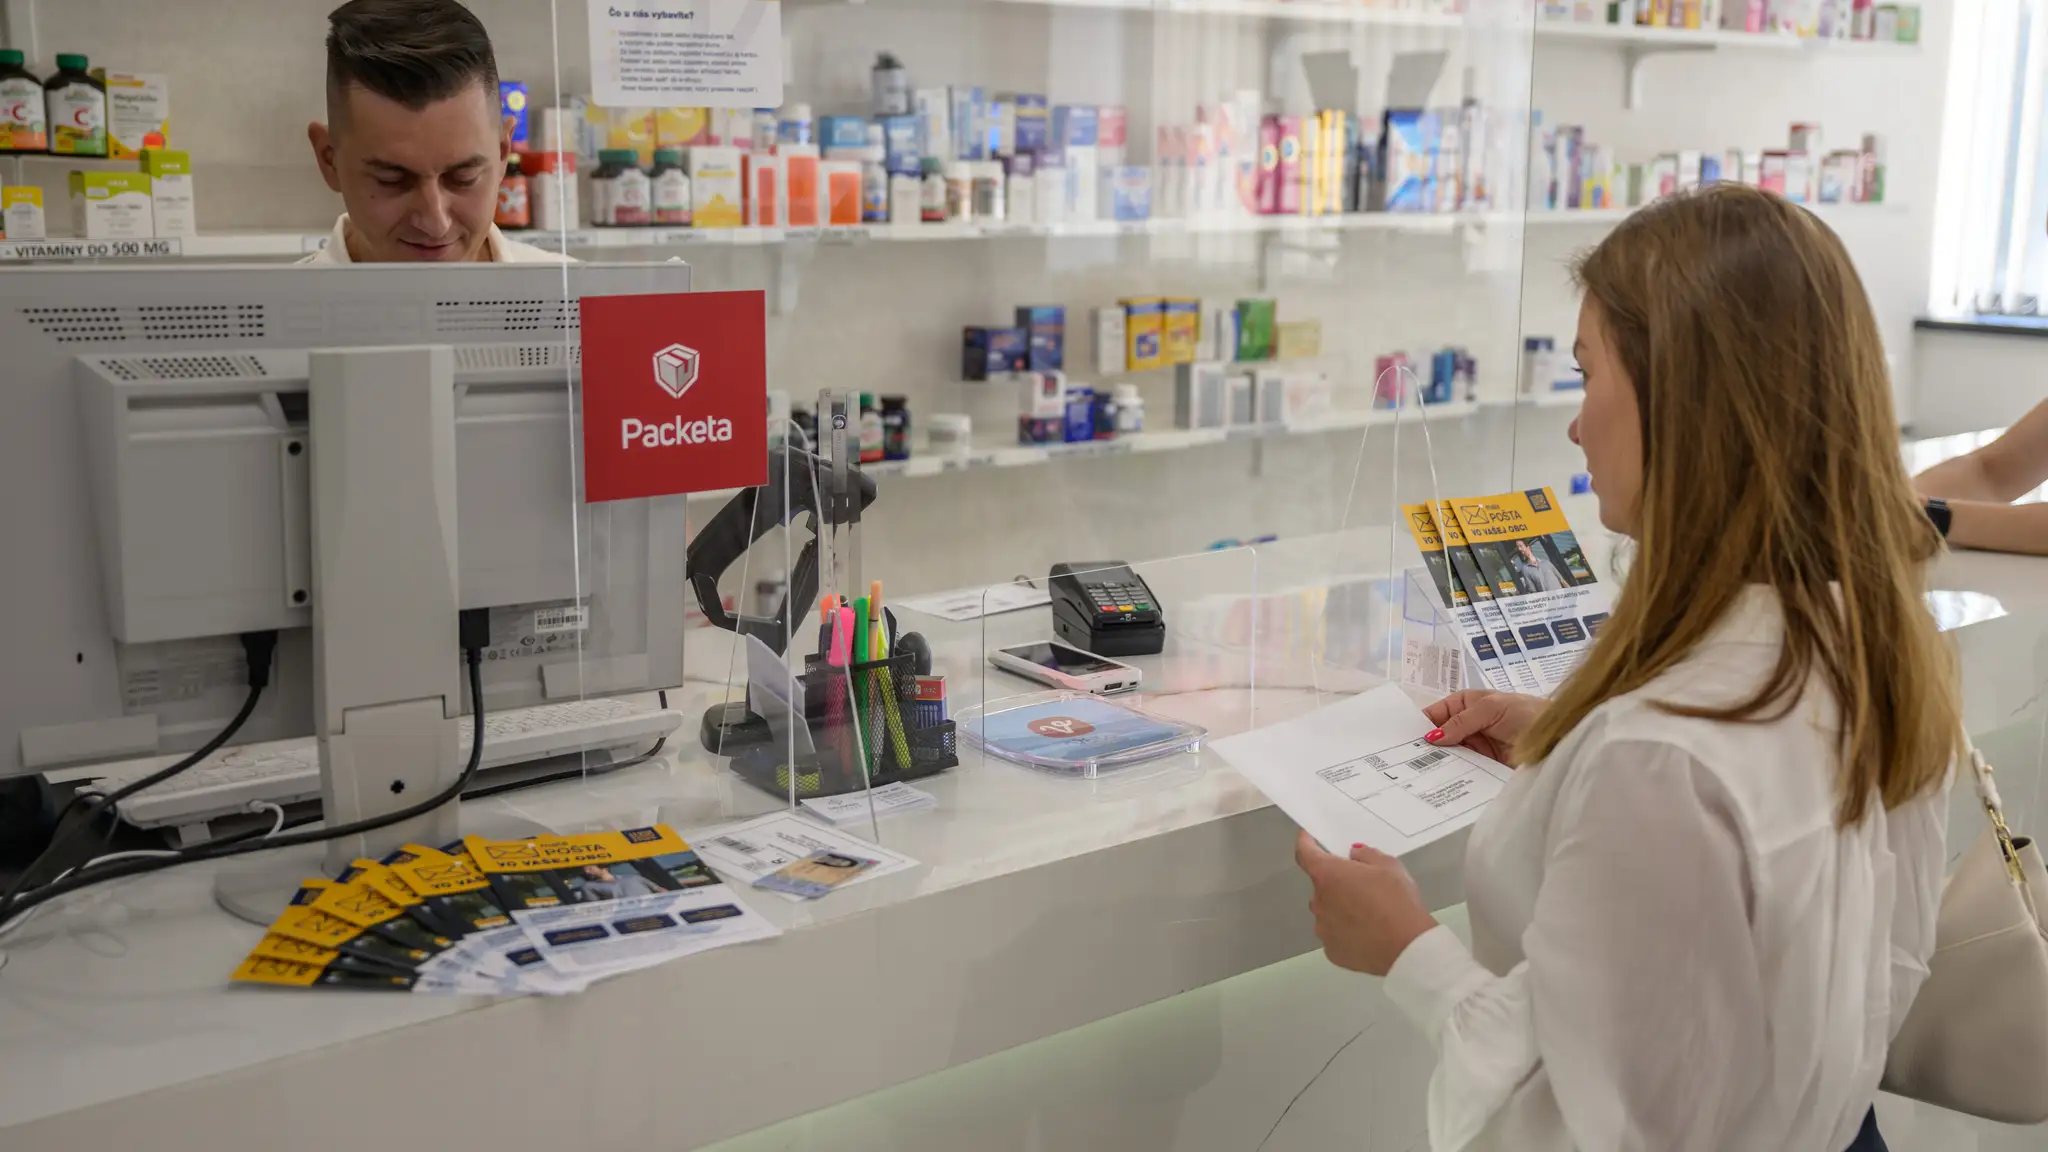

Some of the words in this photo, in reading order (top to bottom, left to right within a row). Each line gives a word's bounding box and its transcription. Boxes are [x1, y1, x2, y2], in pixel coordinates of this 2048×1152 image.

[609, 6, 621, 17] Čo
[633, 9, 649, 18] nás
[15, 243, 83, 257] VITAMÍNY
[87, 243, 107, 256] DO
[112, 241, 139, 256] 500
[144, 240, 169, 254] MG
[621, 415, 732, 450] Packeta
[1489, 509, 1523, 522] POŠTA
[1447, 531, 1459, 540] VO
[1470, 528, 1482, 536] VO
[1482, 525, 1507, 535] VAŠEJ
[1507, 523, 1528, 533] OBCI
[544, 843, 607, 856] POŠTA
[522, 856, 571, 866] VAŠEJ
[575, 852, 613, 861] OBCI
